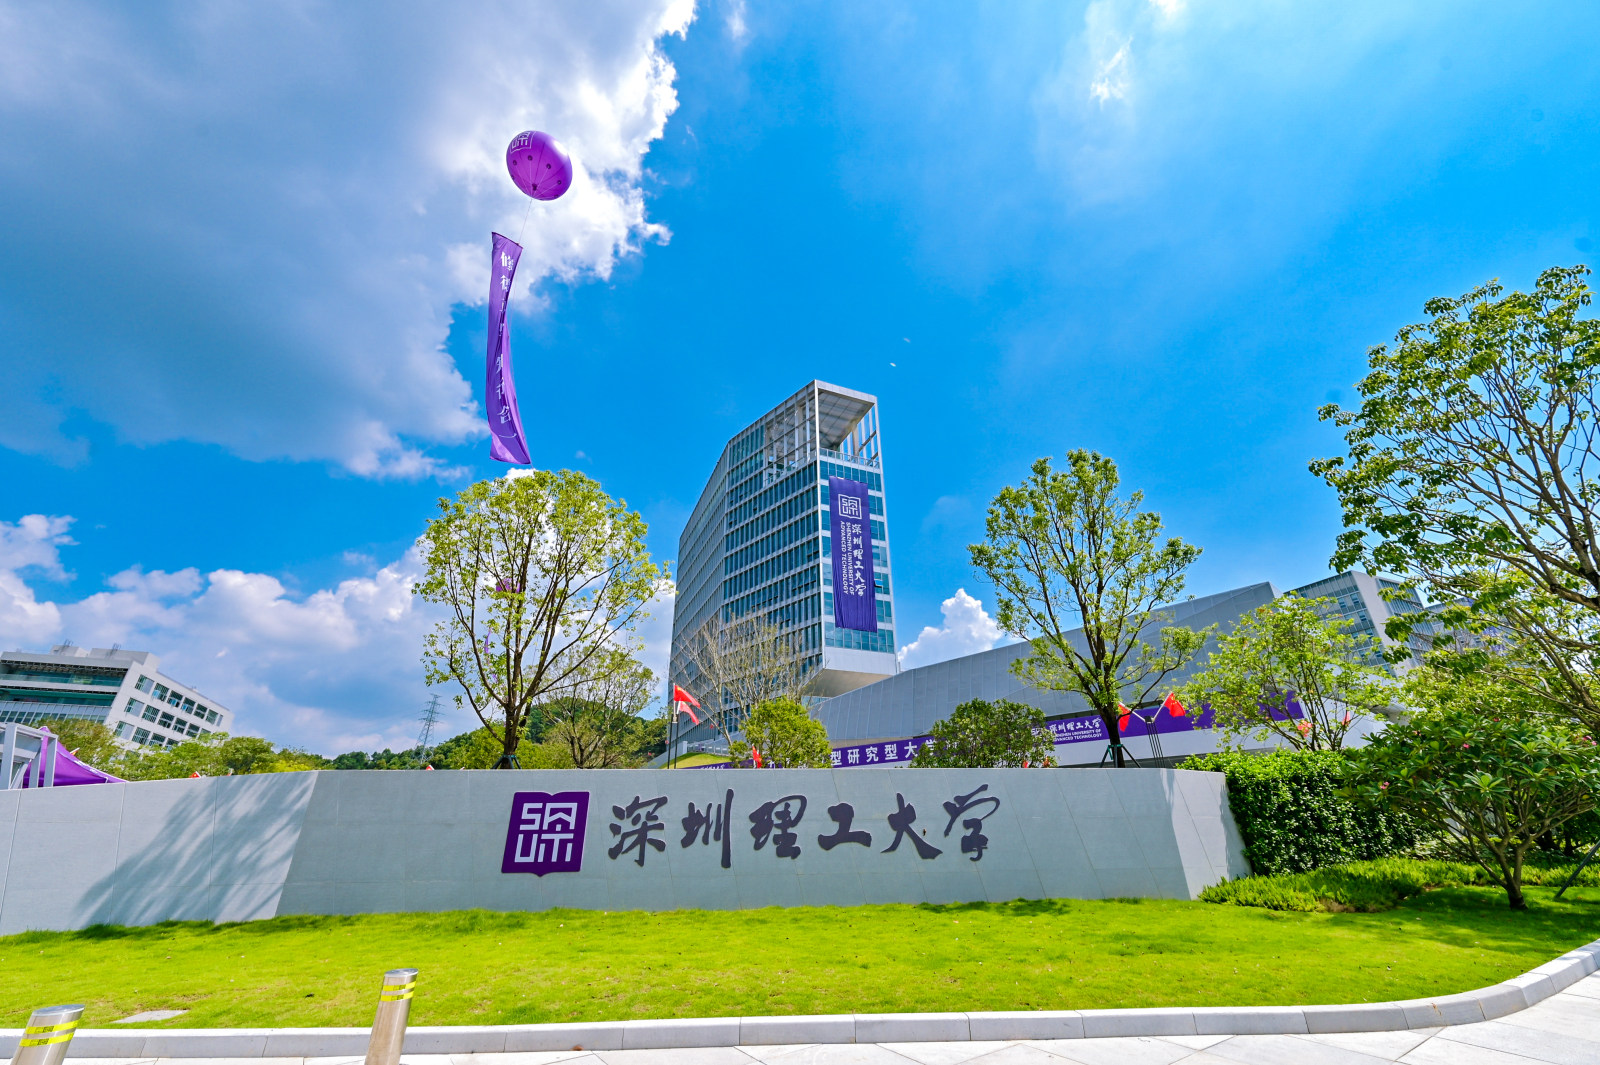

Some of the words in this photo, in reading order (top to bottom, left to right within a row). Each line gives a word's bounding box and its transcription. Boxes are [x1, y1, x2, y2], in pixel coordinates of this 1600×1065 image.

[850, 586, 855, 596] OF
[852, 523, 866, 597] 深圳理工大学
[608, 784, 1000, 868] 深圳理工大学
